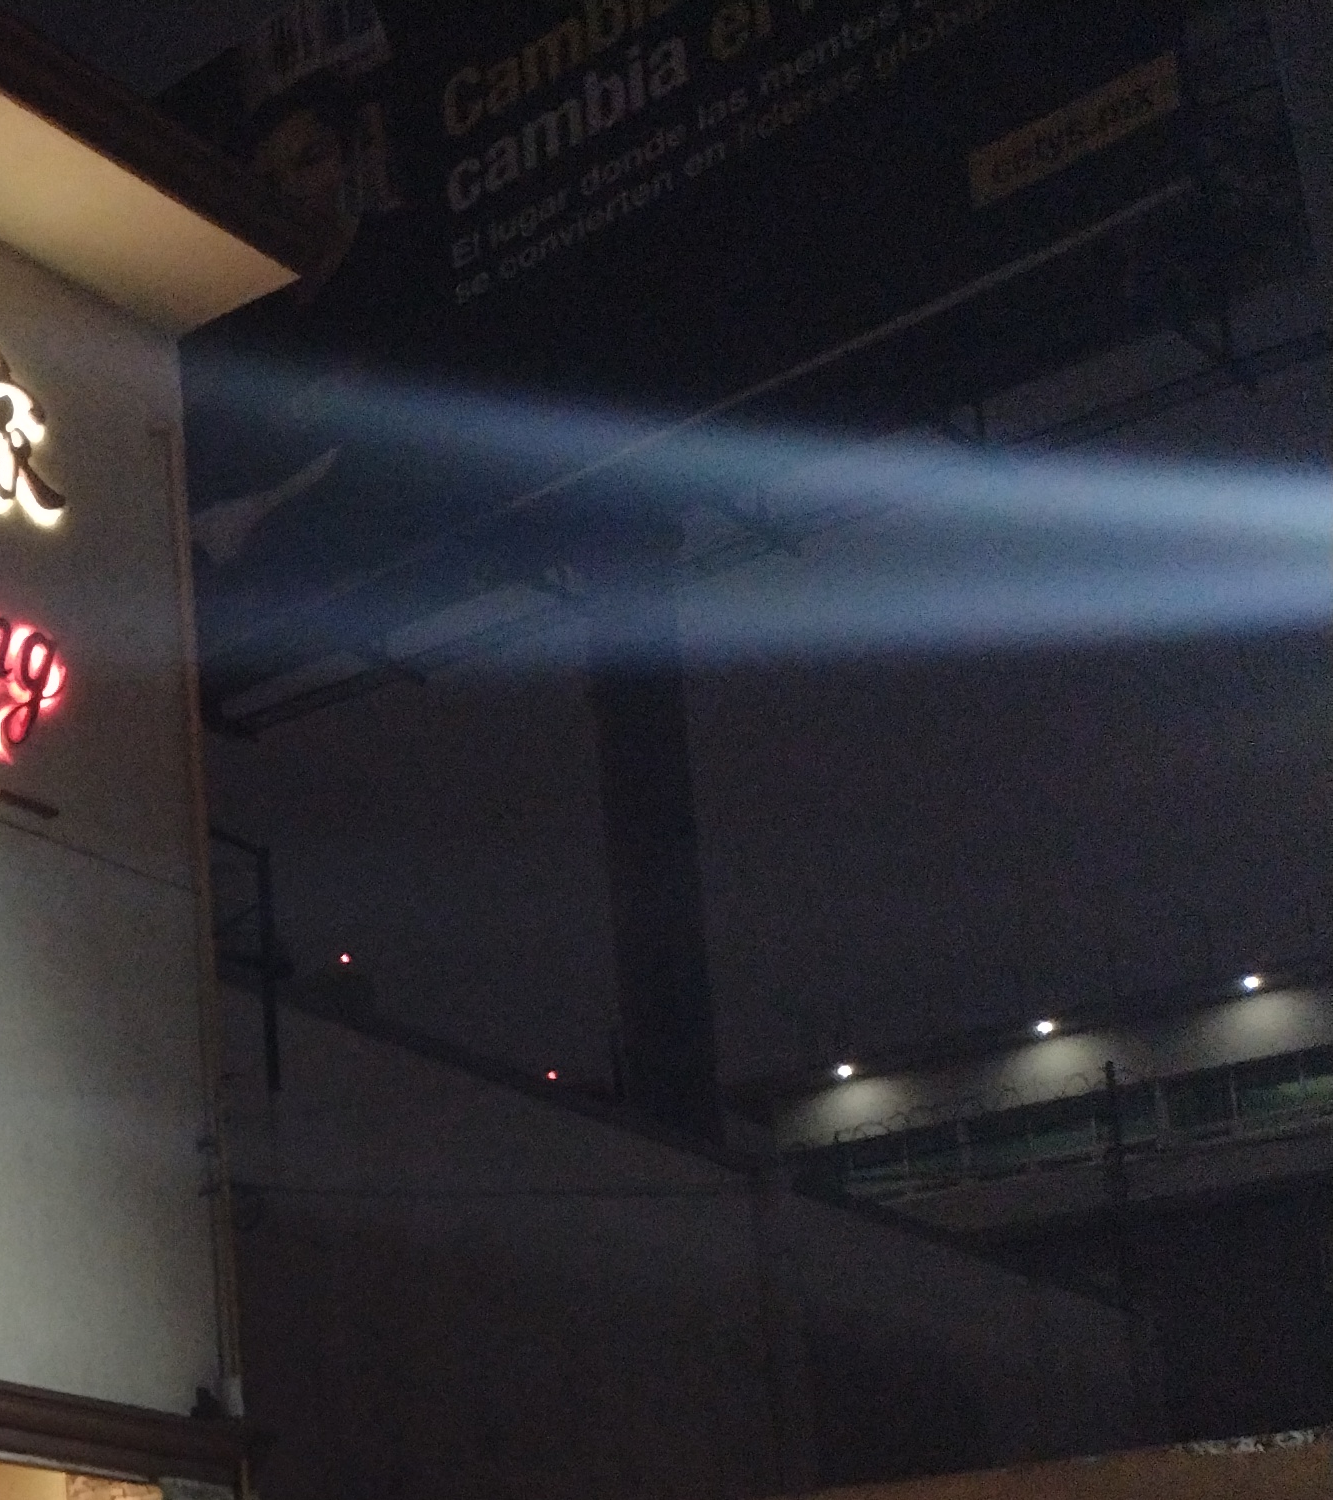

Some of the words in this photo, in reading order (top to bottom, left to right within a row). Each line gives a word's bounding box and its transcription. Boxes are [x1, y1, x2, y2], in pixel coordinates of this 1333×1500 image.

[447, 36, 689, 214] cambia
[452, 231, 481, 269] El
[487, 188, 569, 248] lugar
[580, 123, 687, 196] donde
